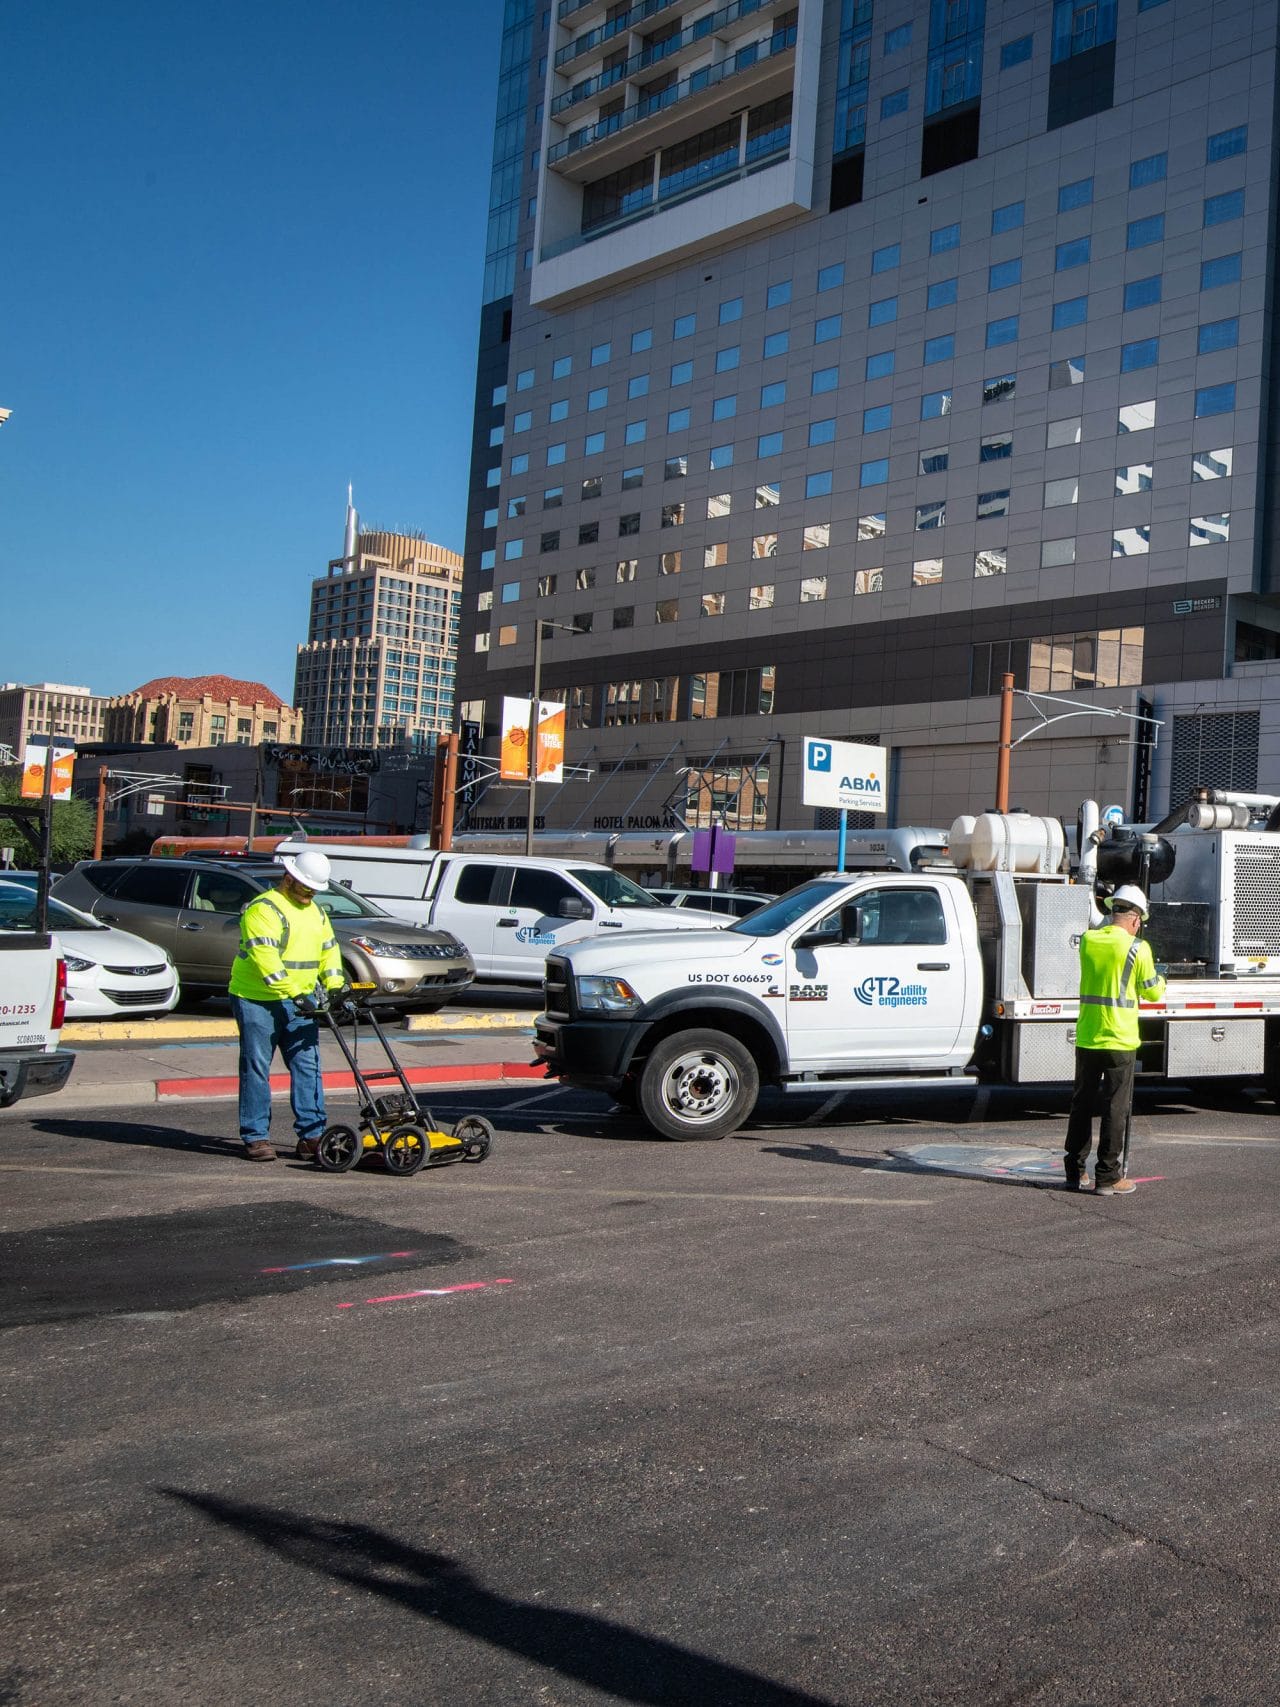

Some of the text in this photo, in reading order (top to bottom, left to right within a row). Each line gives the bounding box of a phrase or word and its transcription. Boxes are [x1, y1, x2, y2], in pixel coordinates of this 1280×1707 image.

[544, 740, 562, 749] RISE
[312, 753, 338, 771] YOU
[813, 746, 827, 768] P
[463, 727, 477, 803] PALOMAR
[839, 776, 881, 793] ABM
[839, 797, 882, 807] Parking Services
[594, 815, 675, 829] HOTEL PALOMAR
[526, 927, 541, 938] T2
[688, 974, 773, 983] US DOT 606659
[874, 976, 927, 996] T2 utility
[789, 990, 828, 998] 5500
[878, 996, 928, 1008] engineers
[0, 1004, 36, 1015] 0-1235
